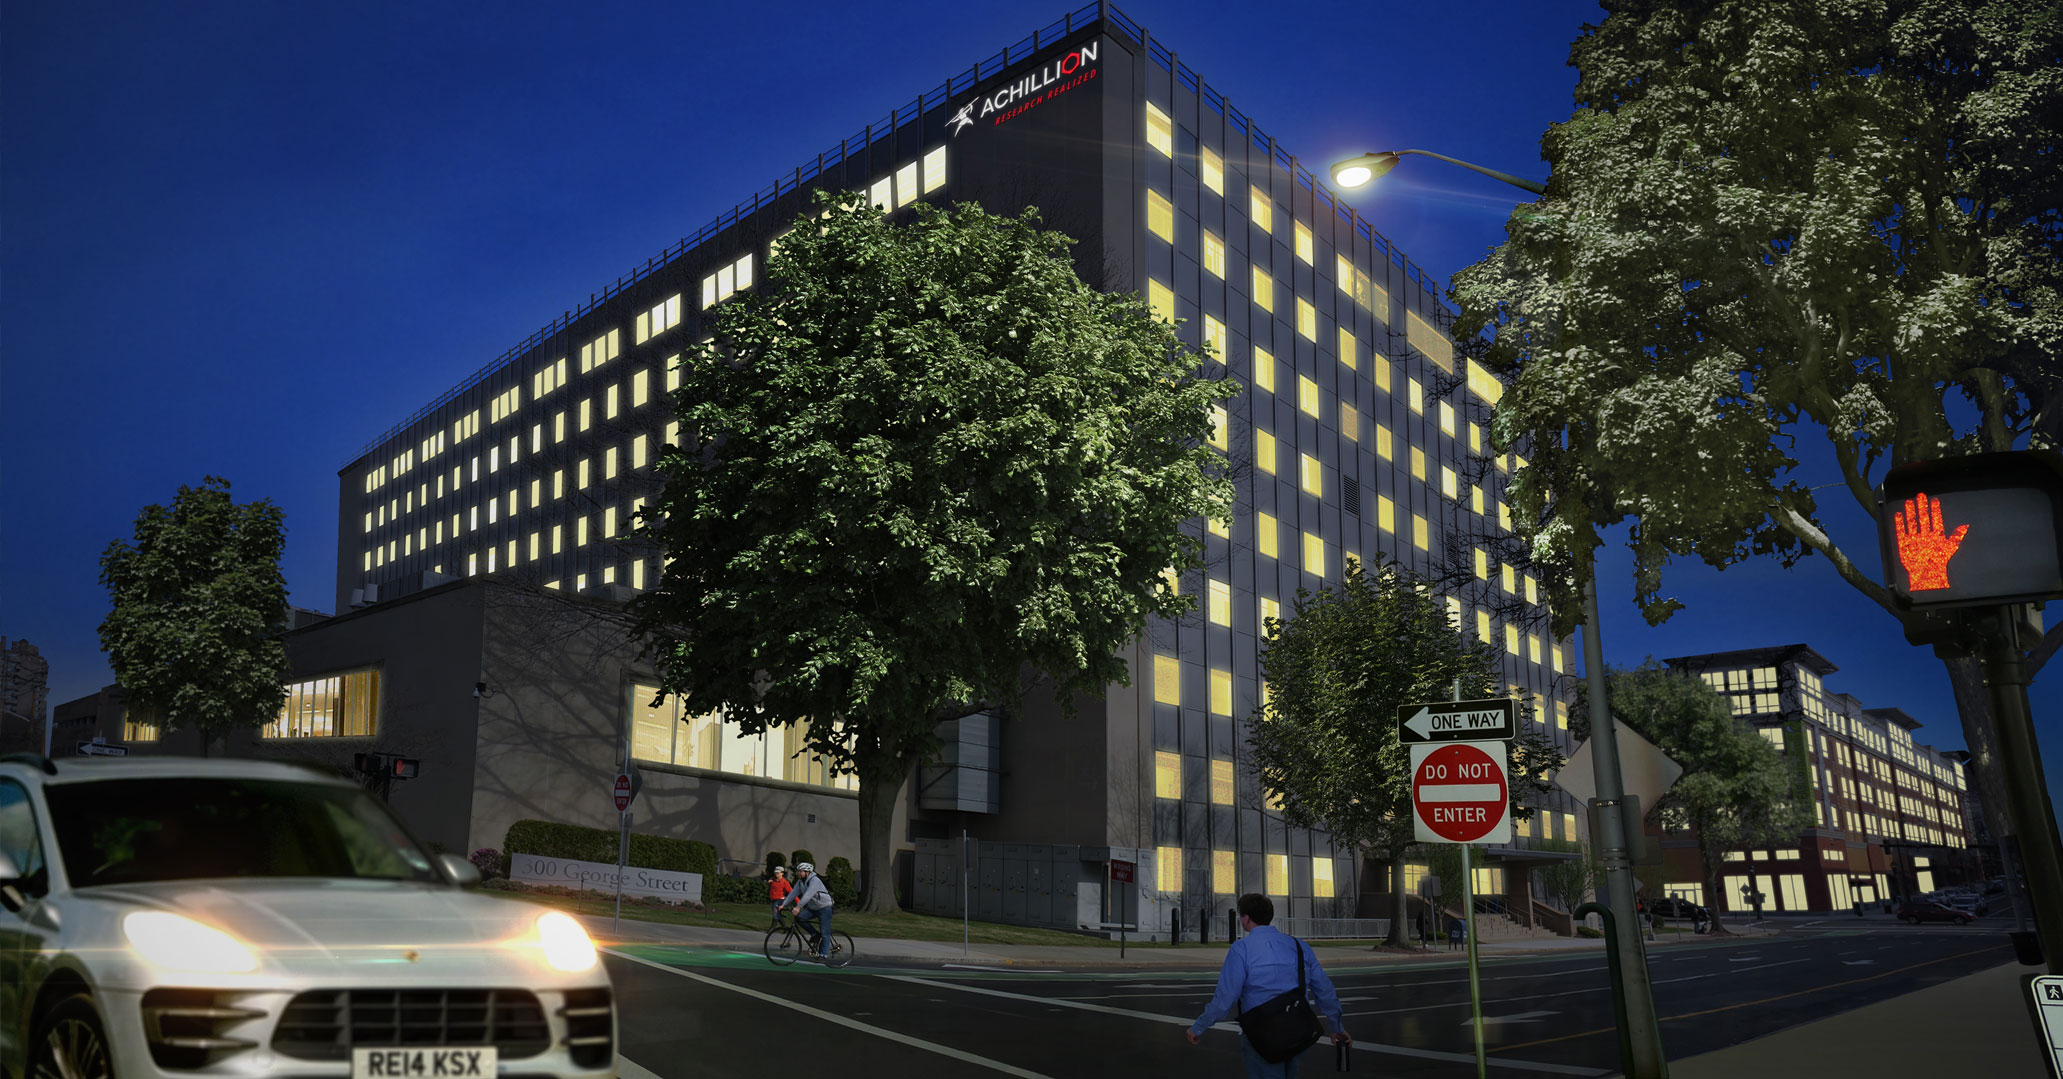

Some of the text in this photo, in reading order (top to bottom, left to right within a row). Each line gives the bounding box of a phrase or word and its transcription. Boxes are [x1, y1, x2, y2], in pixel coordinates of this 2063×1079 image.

[980, 41, 1098, 119] ACHILLION
[995, 69, 1097, 126] RESEARCH REALIZED
[1431, 711, 1500, 730] ONE WAY
[1425, 763, 1491, 779] DO NOT
[1434, 808, 1486, 822] ENTER
[563, 863, 630, 889] George
[636, 871, 689, 892] Street
[368, 1051, 482, 1077] RE14 KSX
